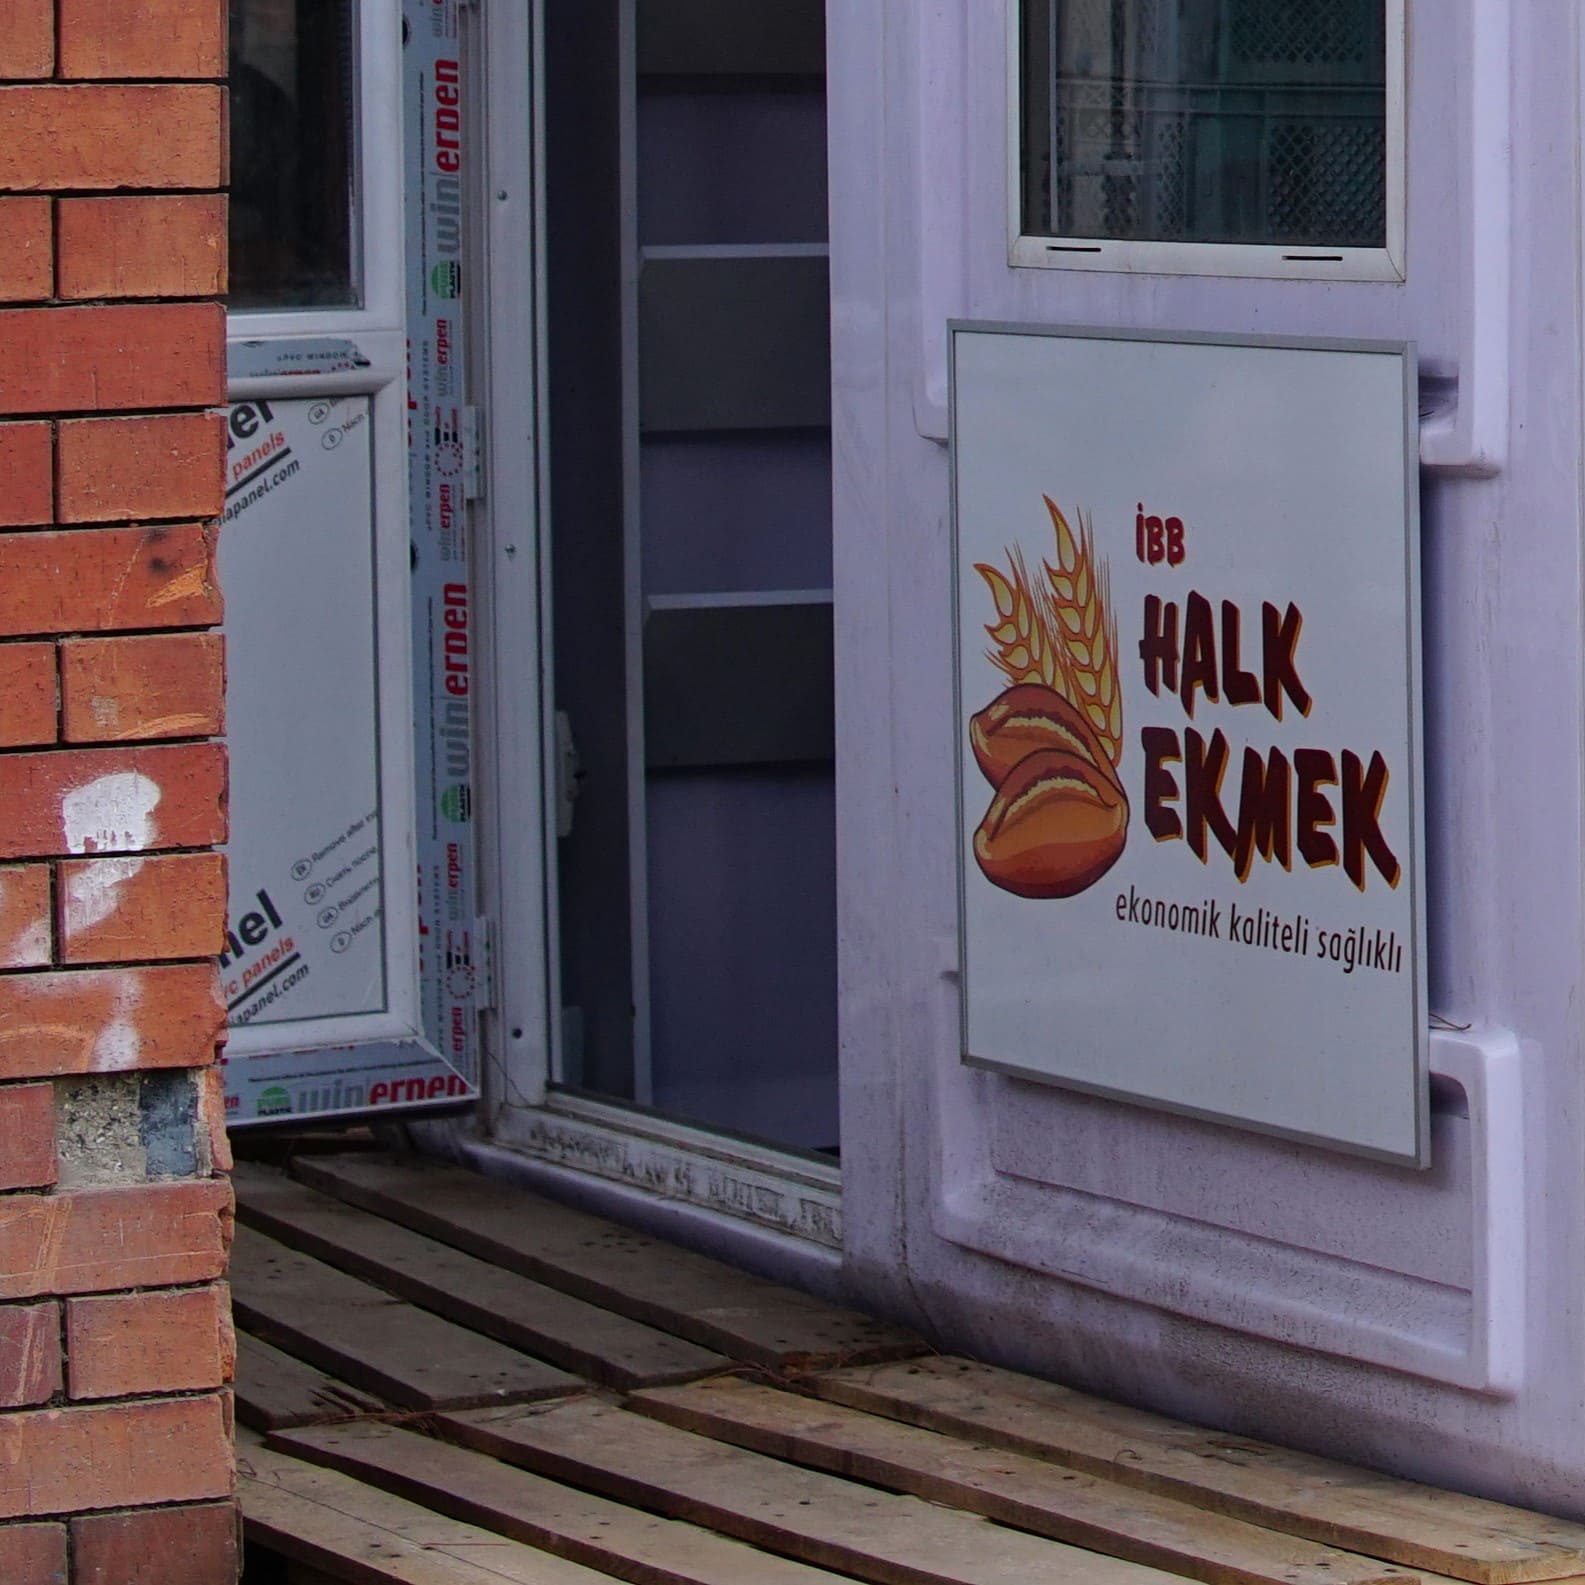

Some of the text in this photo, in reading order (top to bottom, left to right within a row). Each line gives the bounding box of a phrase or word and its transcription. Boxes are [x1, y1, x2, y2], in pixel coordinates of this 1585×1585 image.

[1136, 502, 1186, 567] İBB
[1138, 590, 1312, 723] HALK
[1141, 726, 1401, 892] EKMEK
[1115, 885, 1402, 974] ekonomik kaliteli sağlıklı
